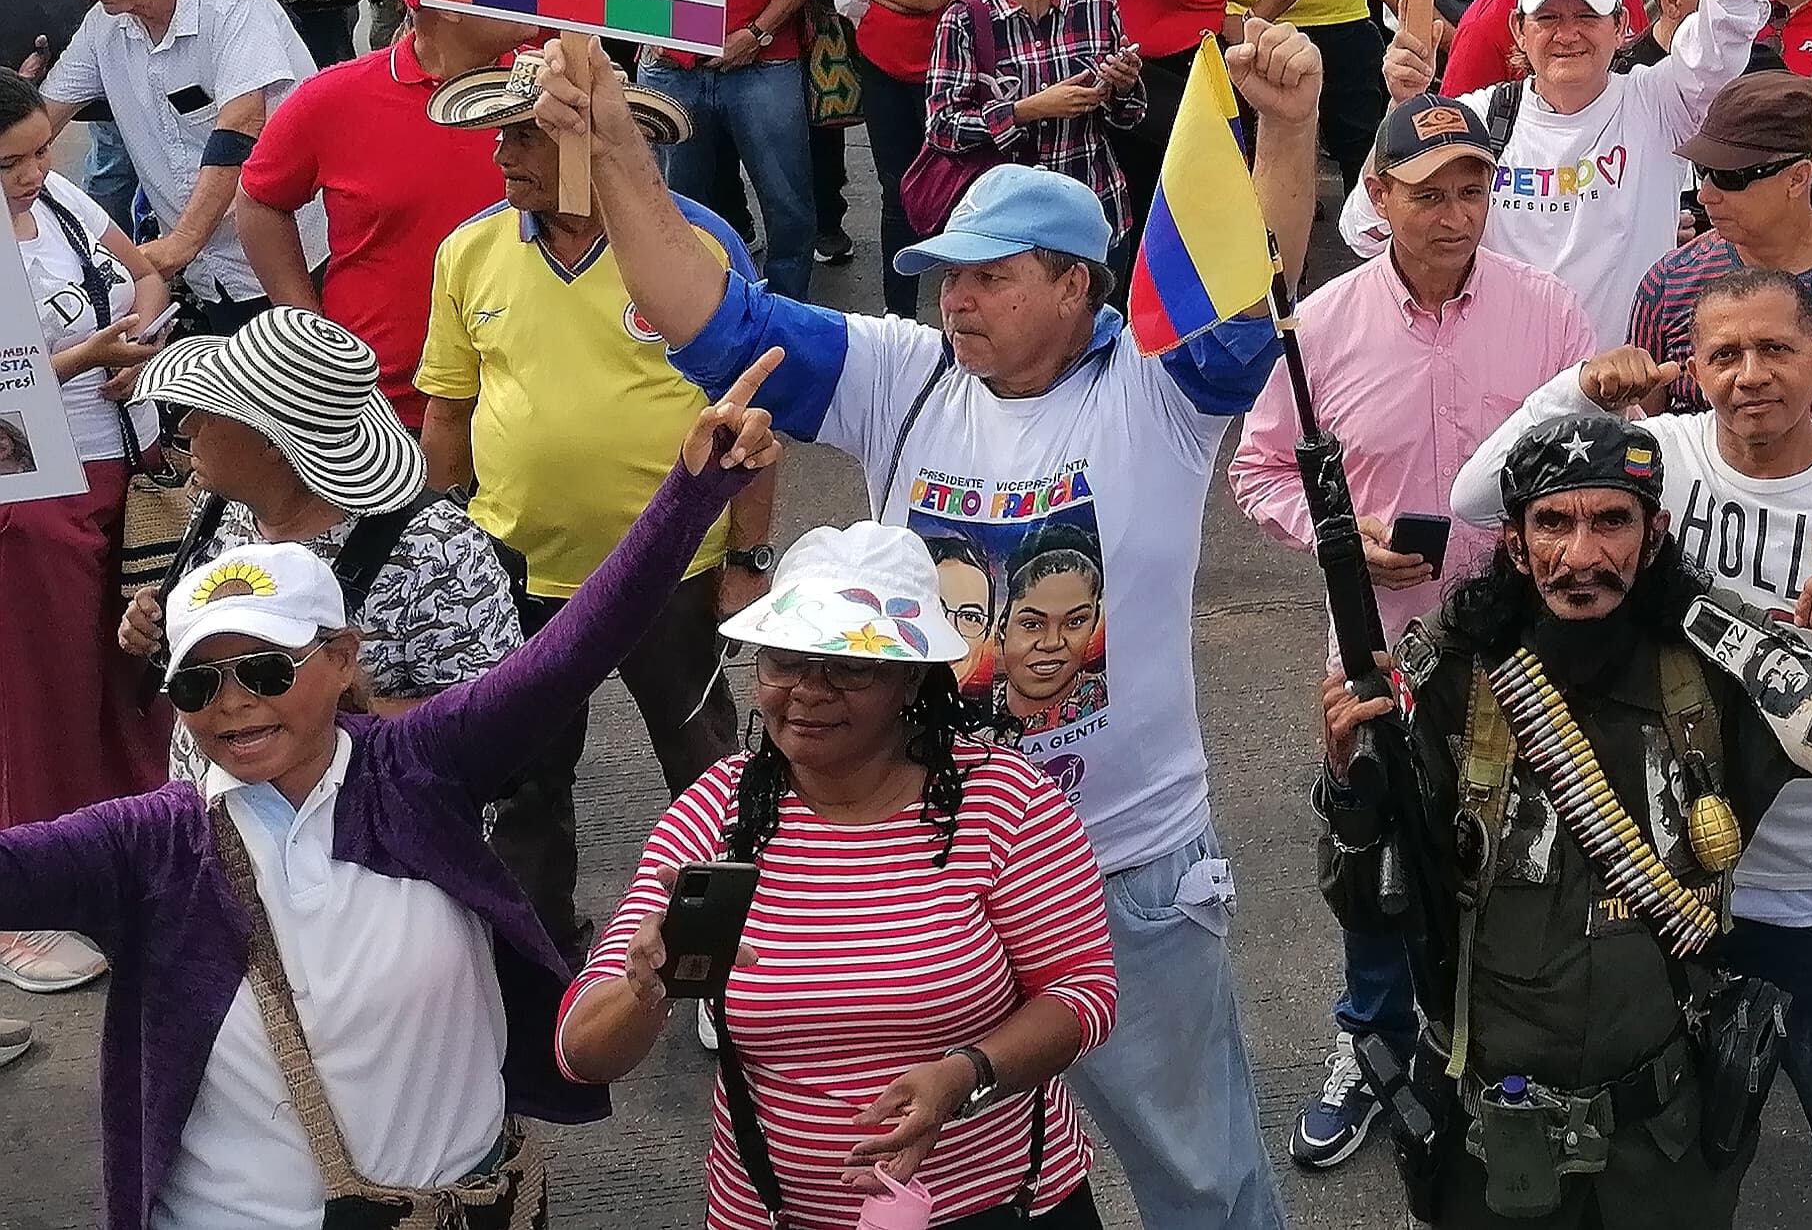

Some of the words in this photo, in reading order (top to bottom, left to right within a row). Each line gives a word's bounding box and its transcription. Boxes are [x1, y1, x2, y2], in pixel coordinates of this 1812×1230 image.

[1493, 159, 1596, 198] PETRO
[910, 478, 982, 517] PETRO
[989, 471, 1094, 518] FRANCIA
[918, 467, 985, 489] PRESIDENTE
[1715, 623, 1748, 666] PAZ
[1050, 714, 1109, 749] GENTE
